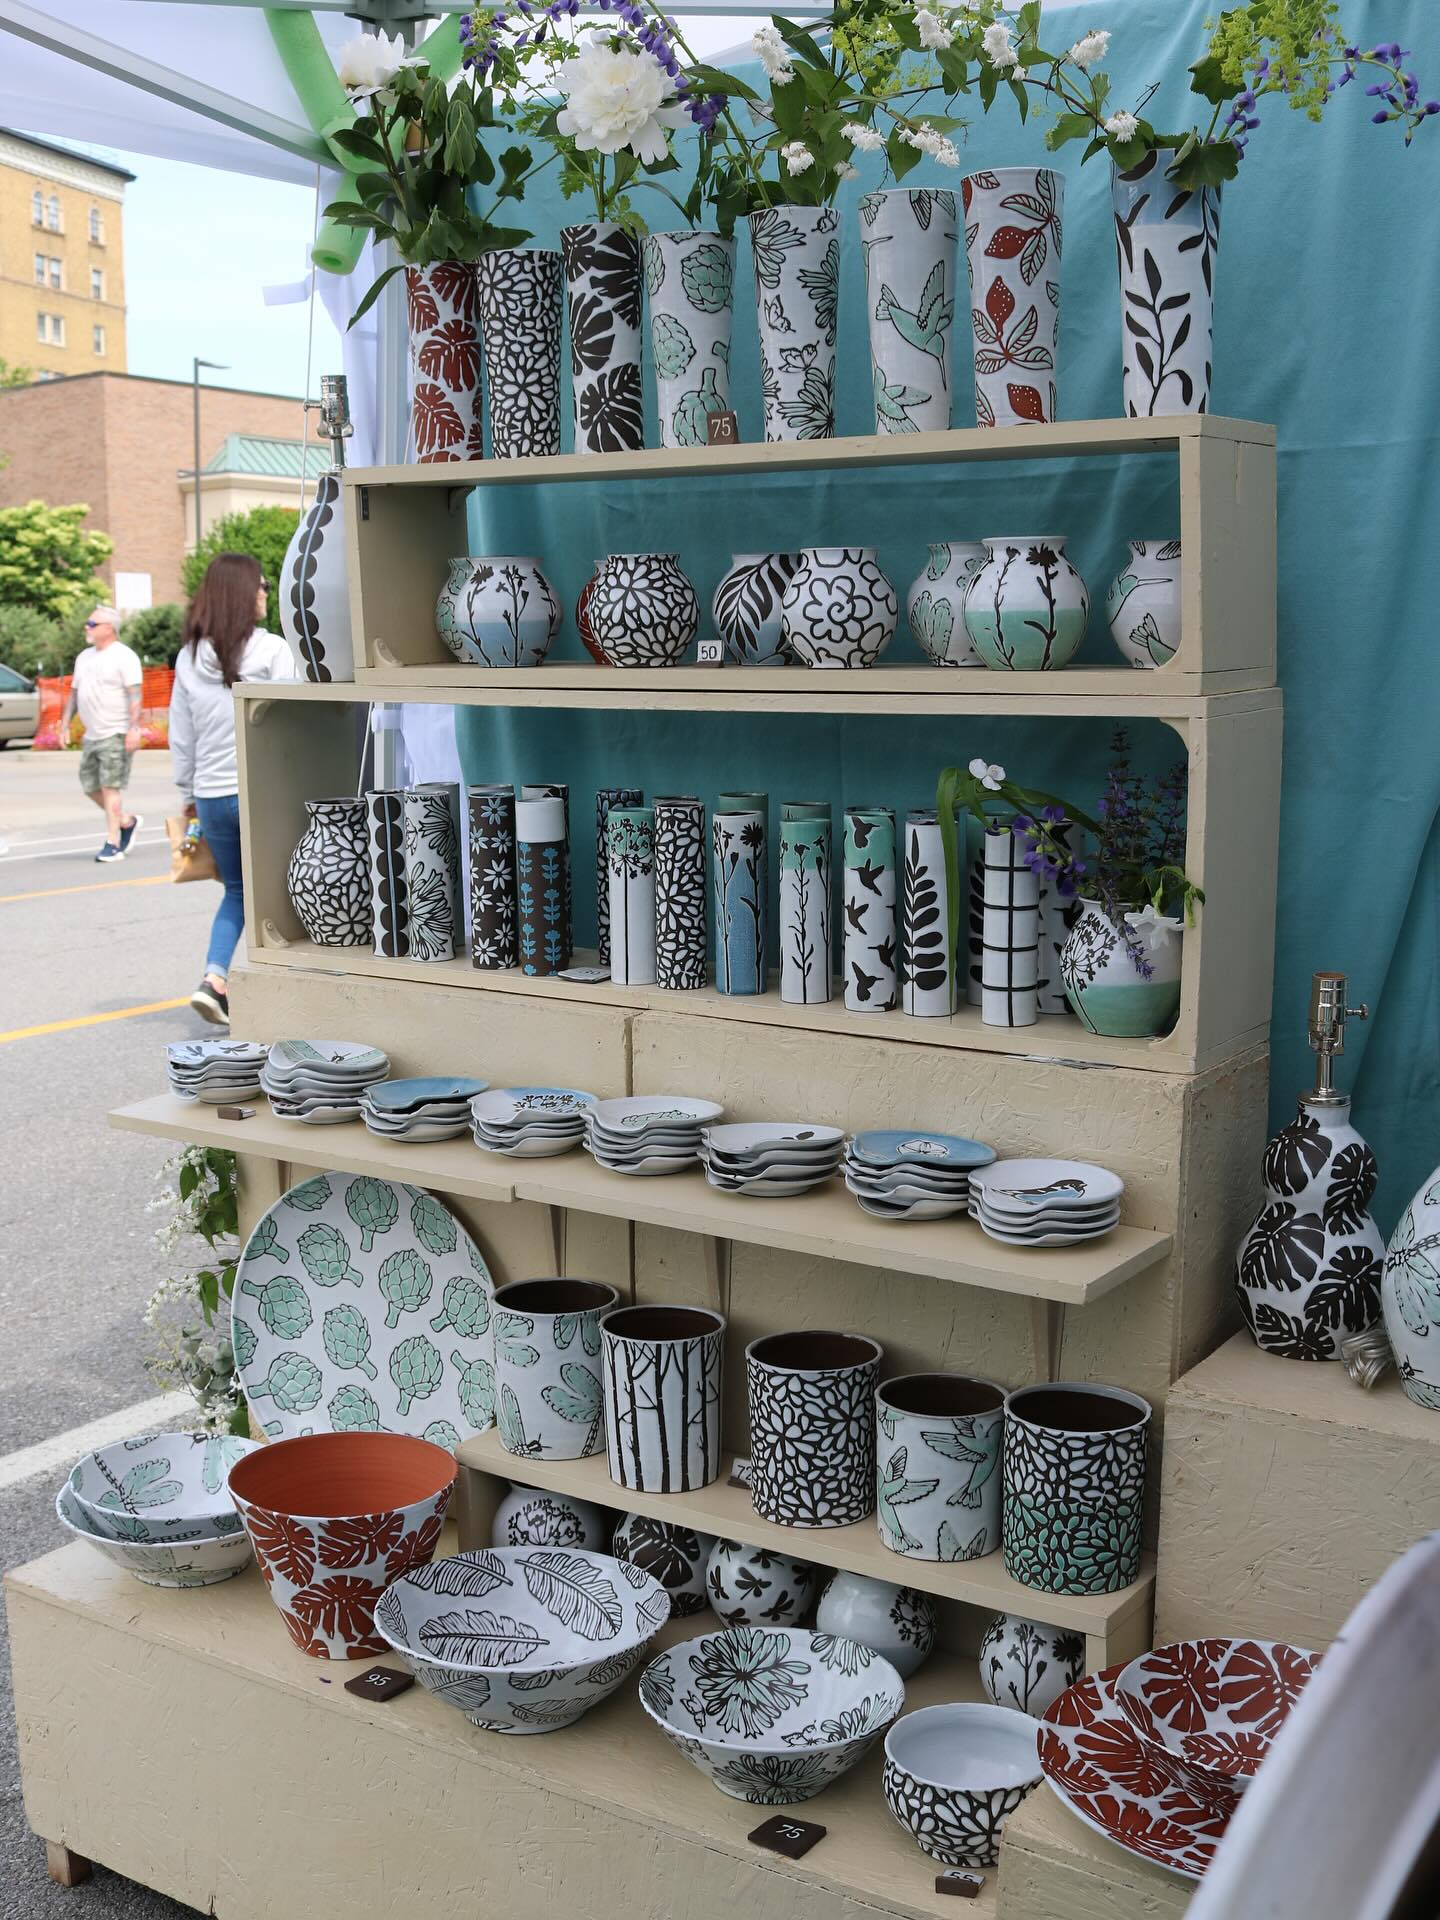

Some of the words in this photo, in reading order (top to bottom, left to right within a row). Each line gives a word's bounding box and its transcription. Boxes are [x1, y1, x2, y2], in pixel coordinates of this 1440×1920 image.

[711, 417, 731, 438] 75
[701, 645, 717, 660] 50
[364, 1673, 391, 1686] 95
[775, 1824, 805, 1839] 75
